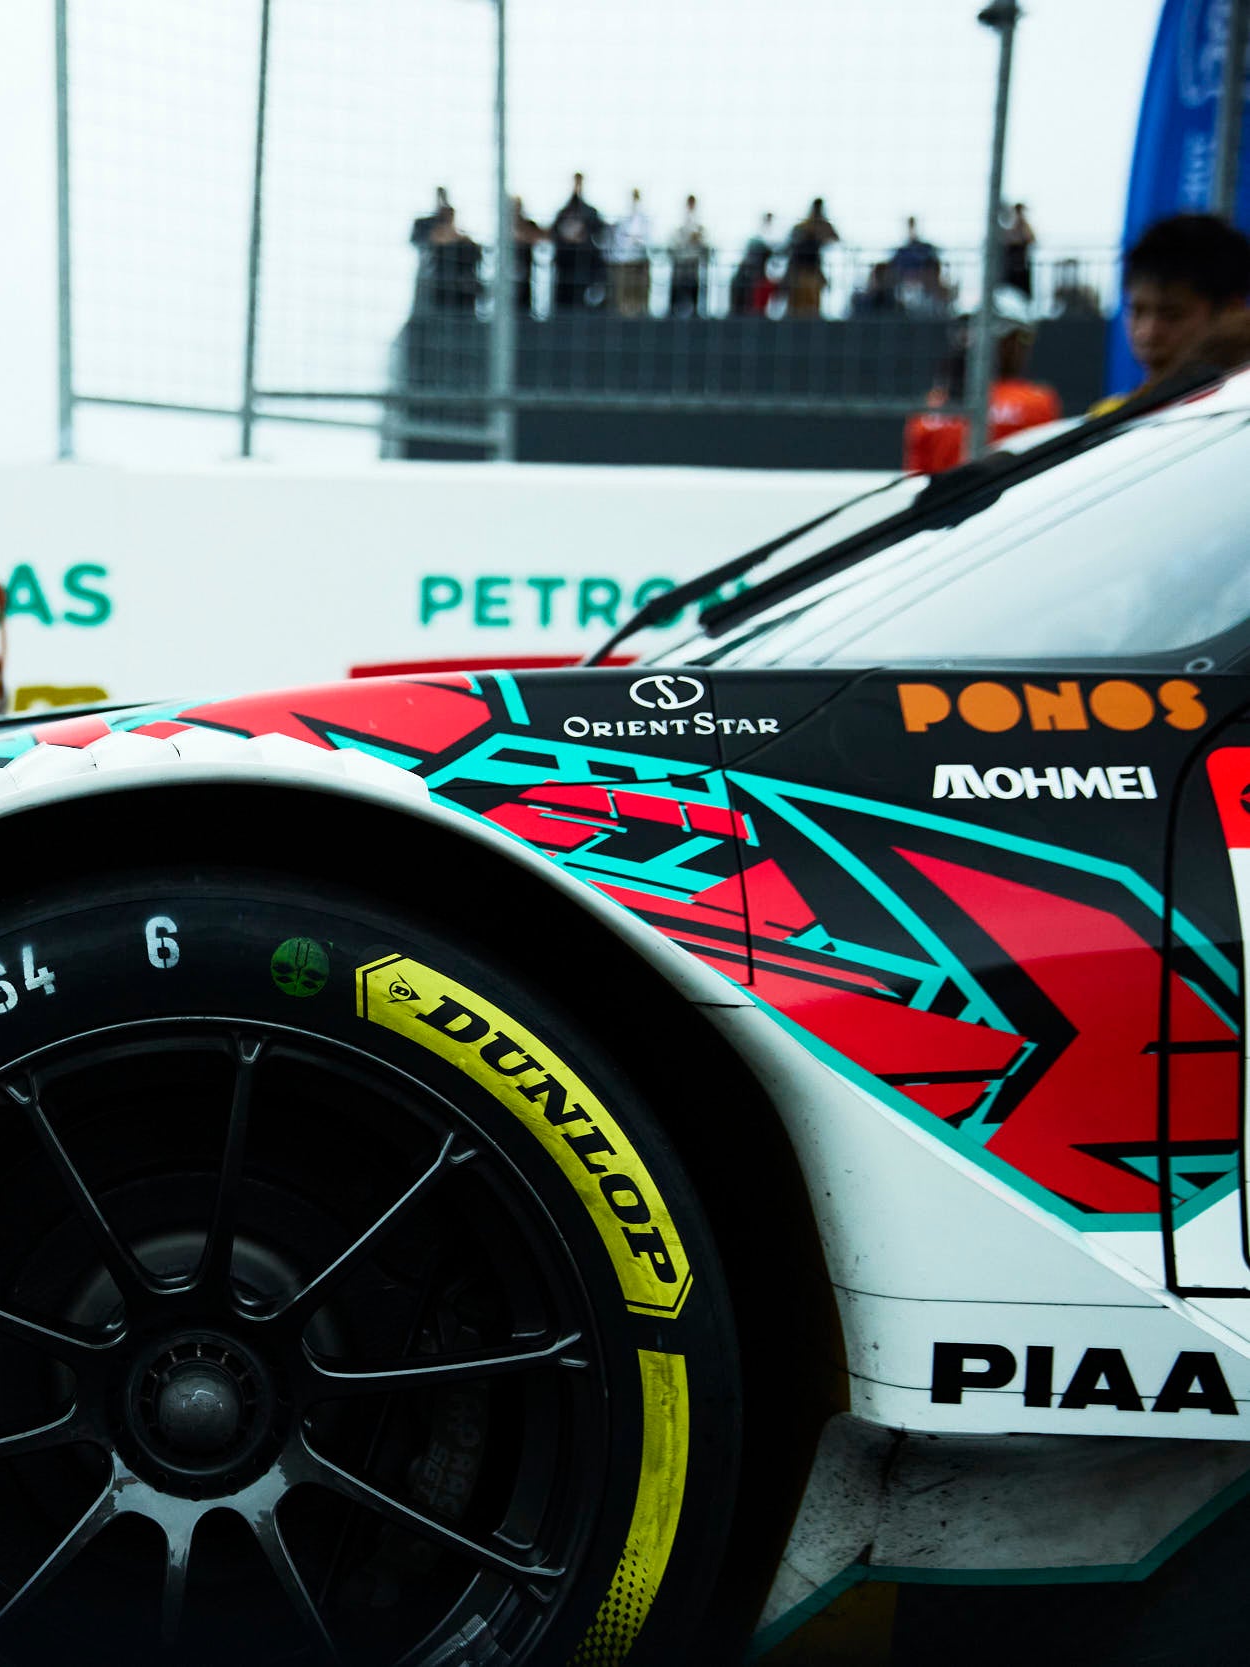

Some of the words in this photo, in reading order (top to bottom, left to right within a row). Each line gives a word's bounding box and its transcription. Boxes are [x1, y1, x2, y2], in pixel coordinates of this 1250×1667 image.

[896, 679, 1208, 733] PONOS
[144, 915, 180, 969] 6
[415, 994, 678, 1284] DUNLOP
[930, 1341, 1240, 1416] PIAA
